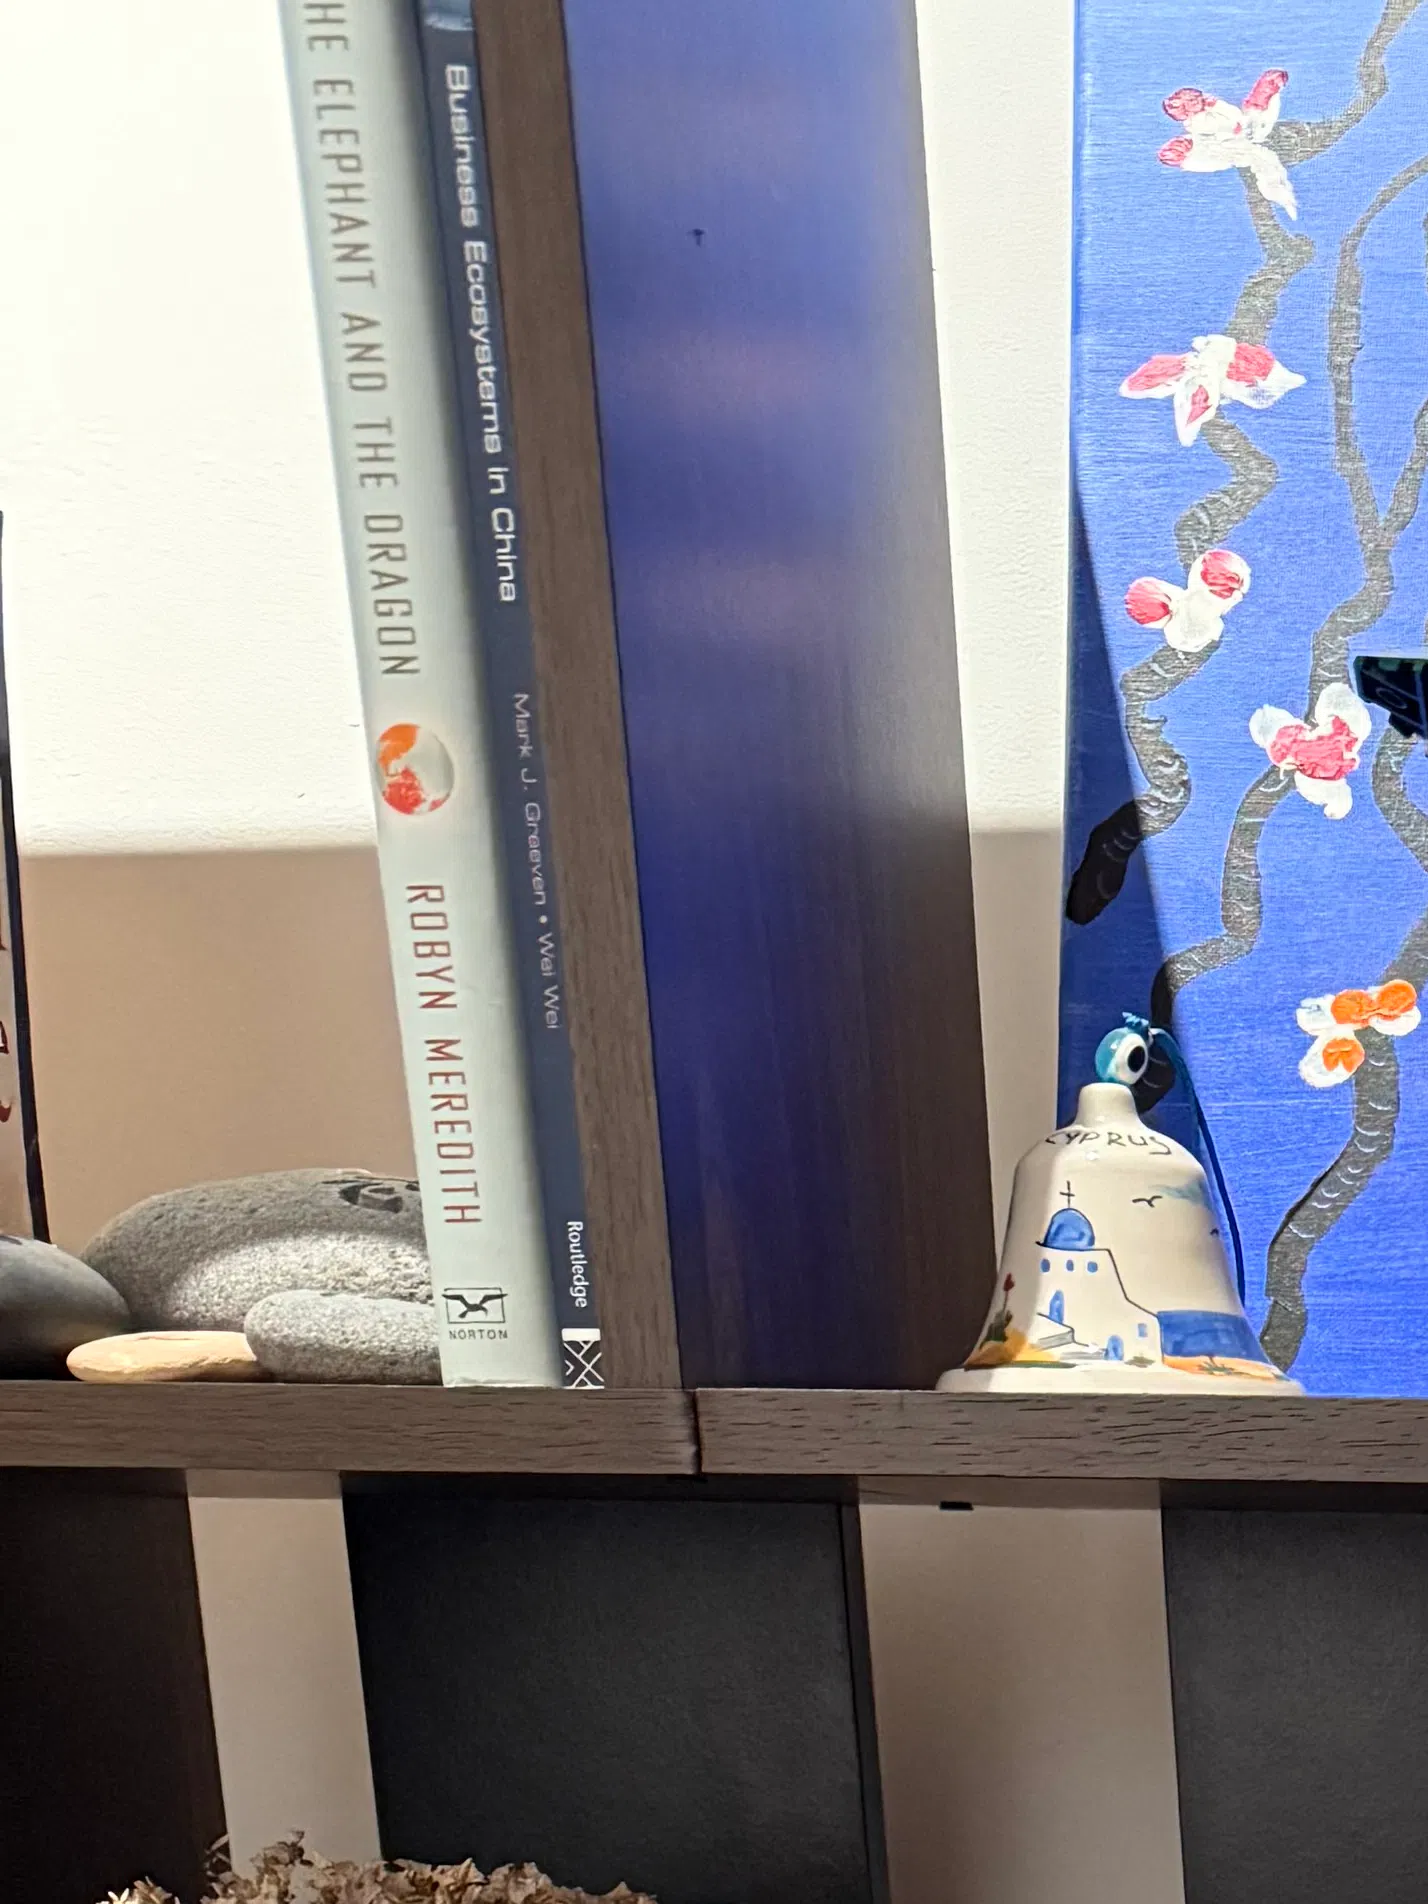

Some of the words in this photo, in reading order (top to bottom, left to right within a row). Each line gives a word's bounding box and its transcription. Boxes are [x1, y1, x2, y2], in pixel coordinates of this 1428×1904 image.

[312, 79, 375, 287] ELEPHANT
[446, 66, 482, 227] Business
[338, 312, 387, 391] AND
[462, 241, 503, 454] Ecosystems
[349, 417, 398, 487] THE
[486, 468, 510, 494] in
[360, 514, 420, 675] DRAGON
[486, 508, 516, 602] China
[408, 883, 460, 1009] ROBYN
[425, 1039, 484, 1225] MEREDITH
[567, 1222, 596, 1308] Routledge
[448, 1328, 509, 1342] NORTON
